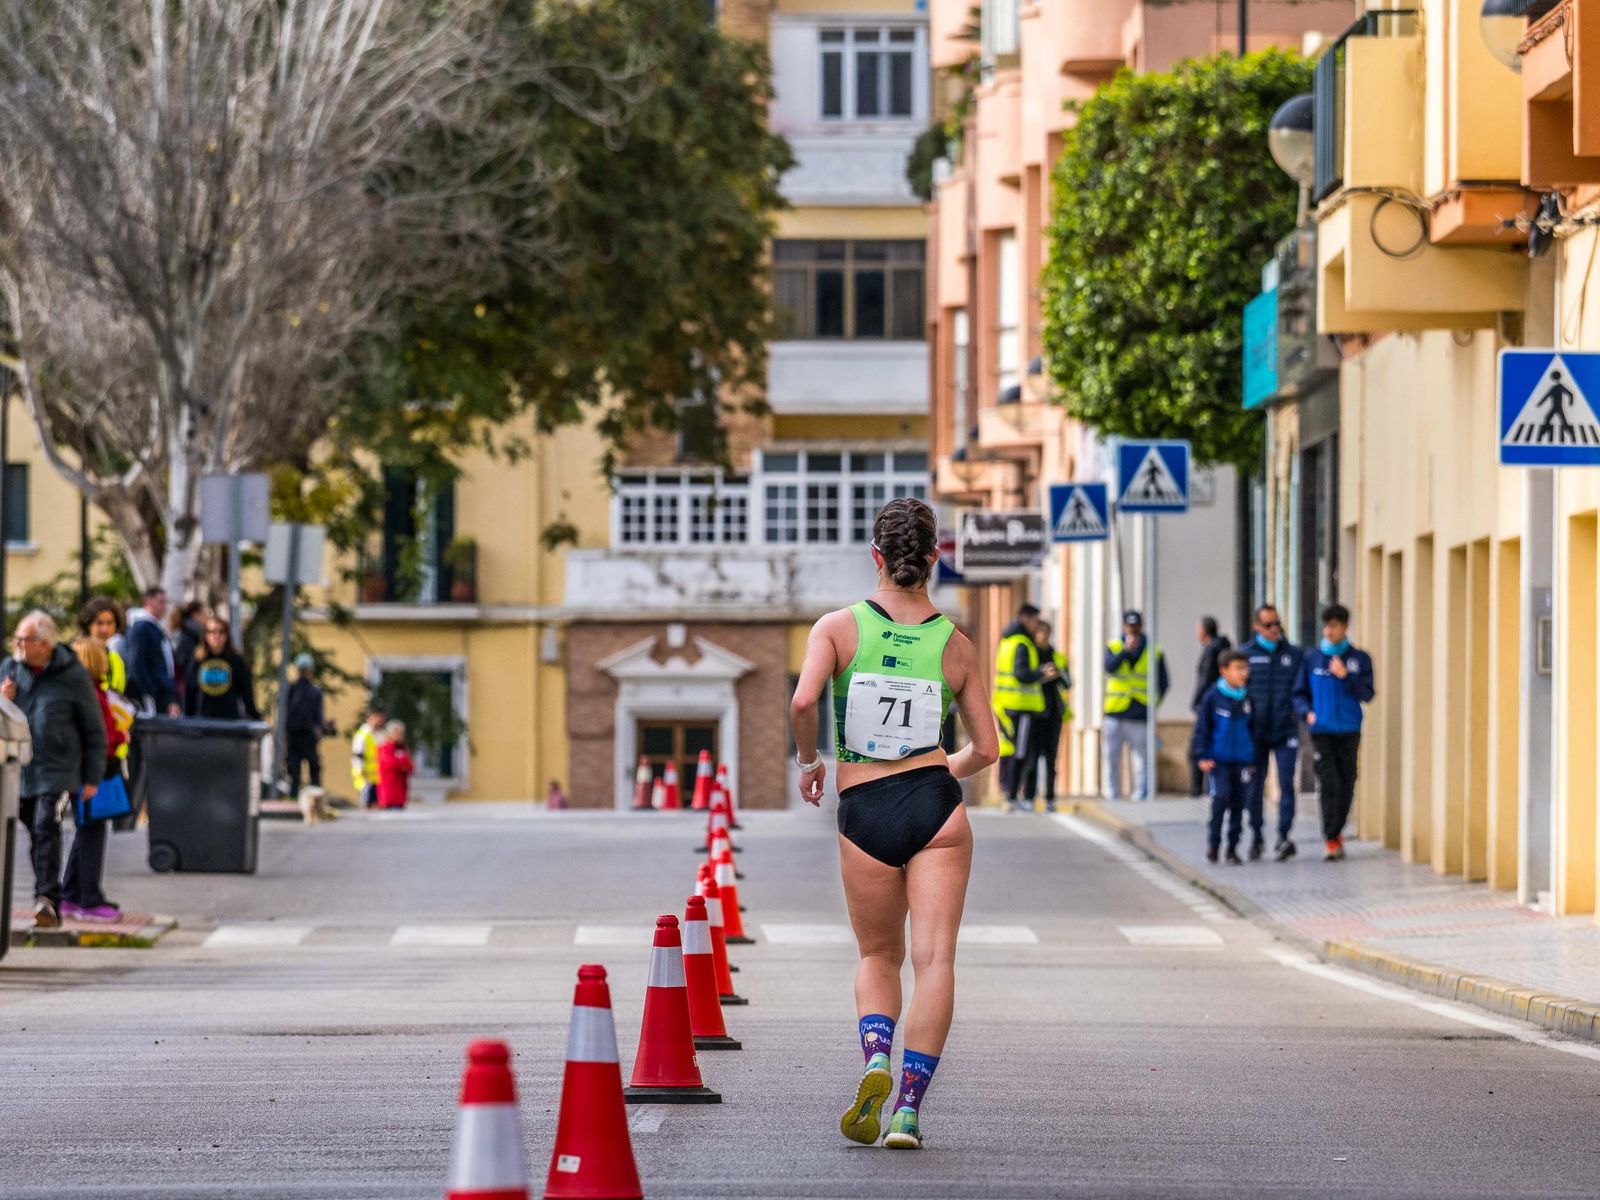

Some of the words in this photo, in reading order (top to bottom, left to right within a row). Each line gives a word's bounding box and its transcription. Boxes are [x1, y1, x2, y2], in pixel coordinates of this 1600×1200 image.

[893, 632, 921, 642] Fundación
[893, 637, 913, 645] Unicaja
[877, 695, 913, 729] 71
